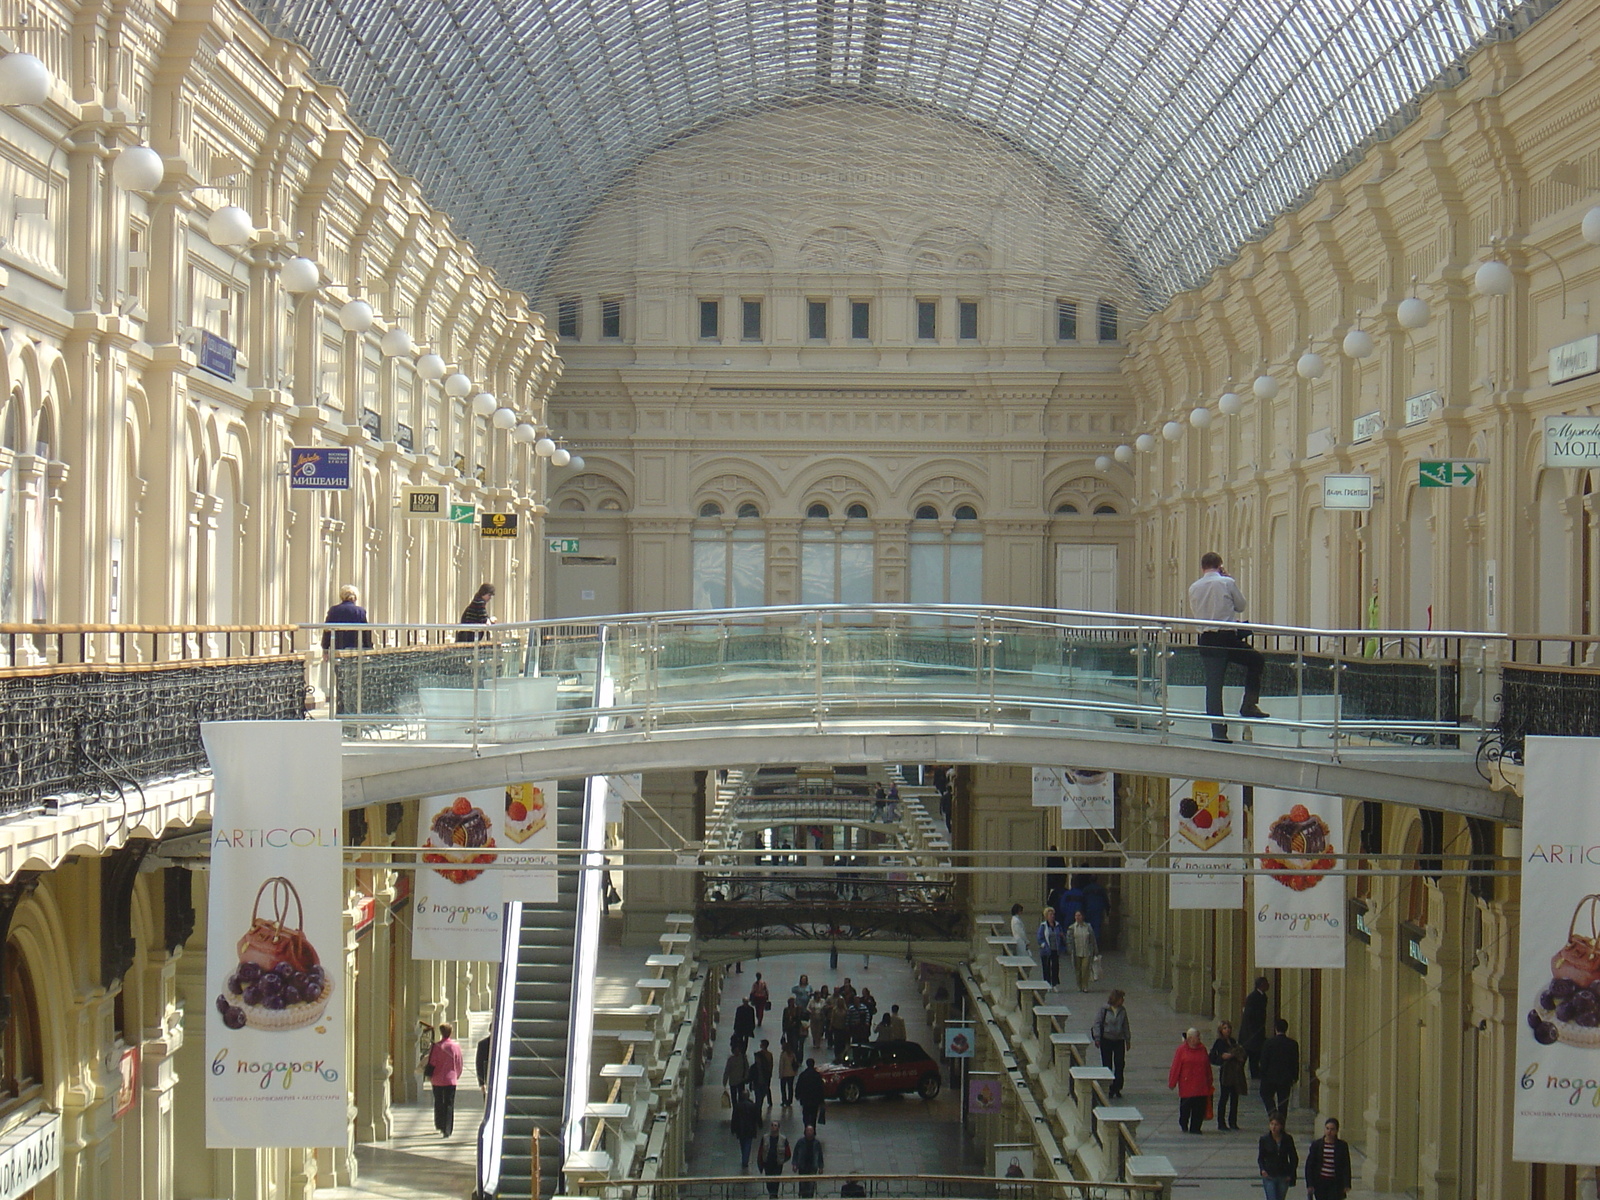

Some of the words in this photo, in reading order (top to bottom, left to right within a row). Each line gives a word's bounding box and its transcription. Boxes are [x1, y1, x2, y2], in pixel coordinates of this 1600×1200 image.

[1554, 442, 1600, 459] МОД
[292, 477, 347, 486] МИШЕЛИН
[412, 494, 436, 505] 1929
[481, 527, 517, 537] navigare
[214, 828, 337, 848] ARTICOLI
[27, 1131, 55, 1179] PABST
